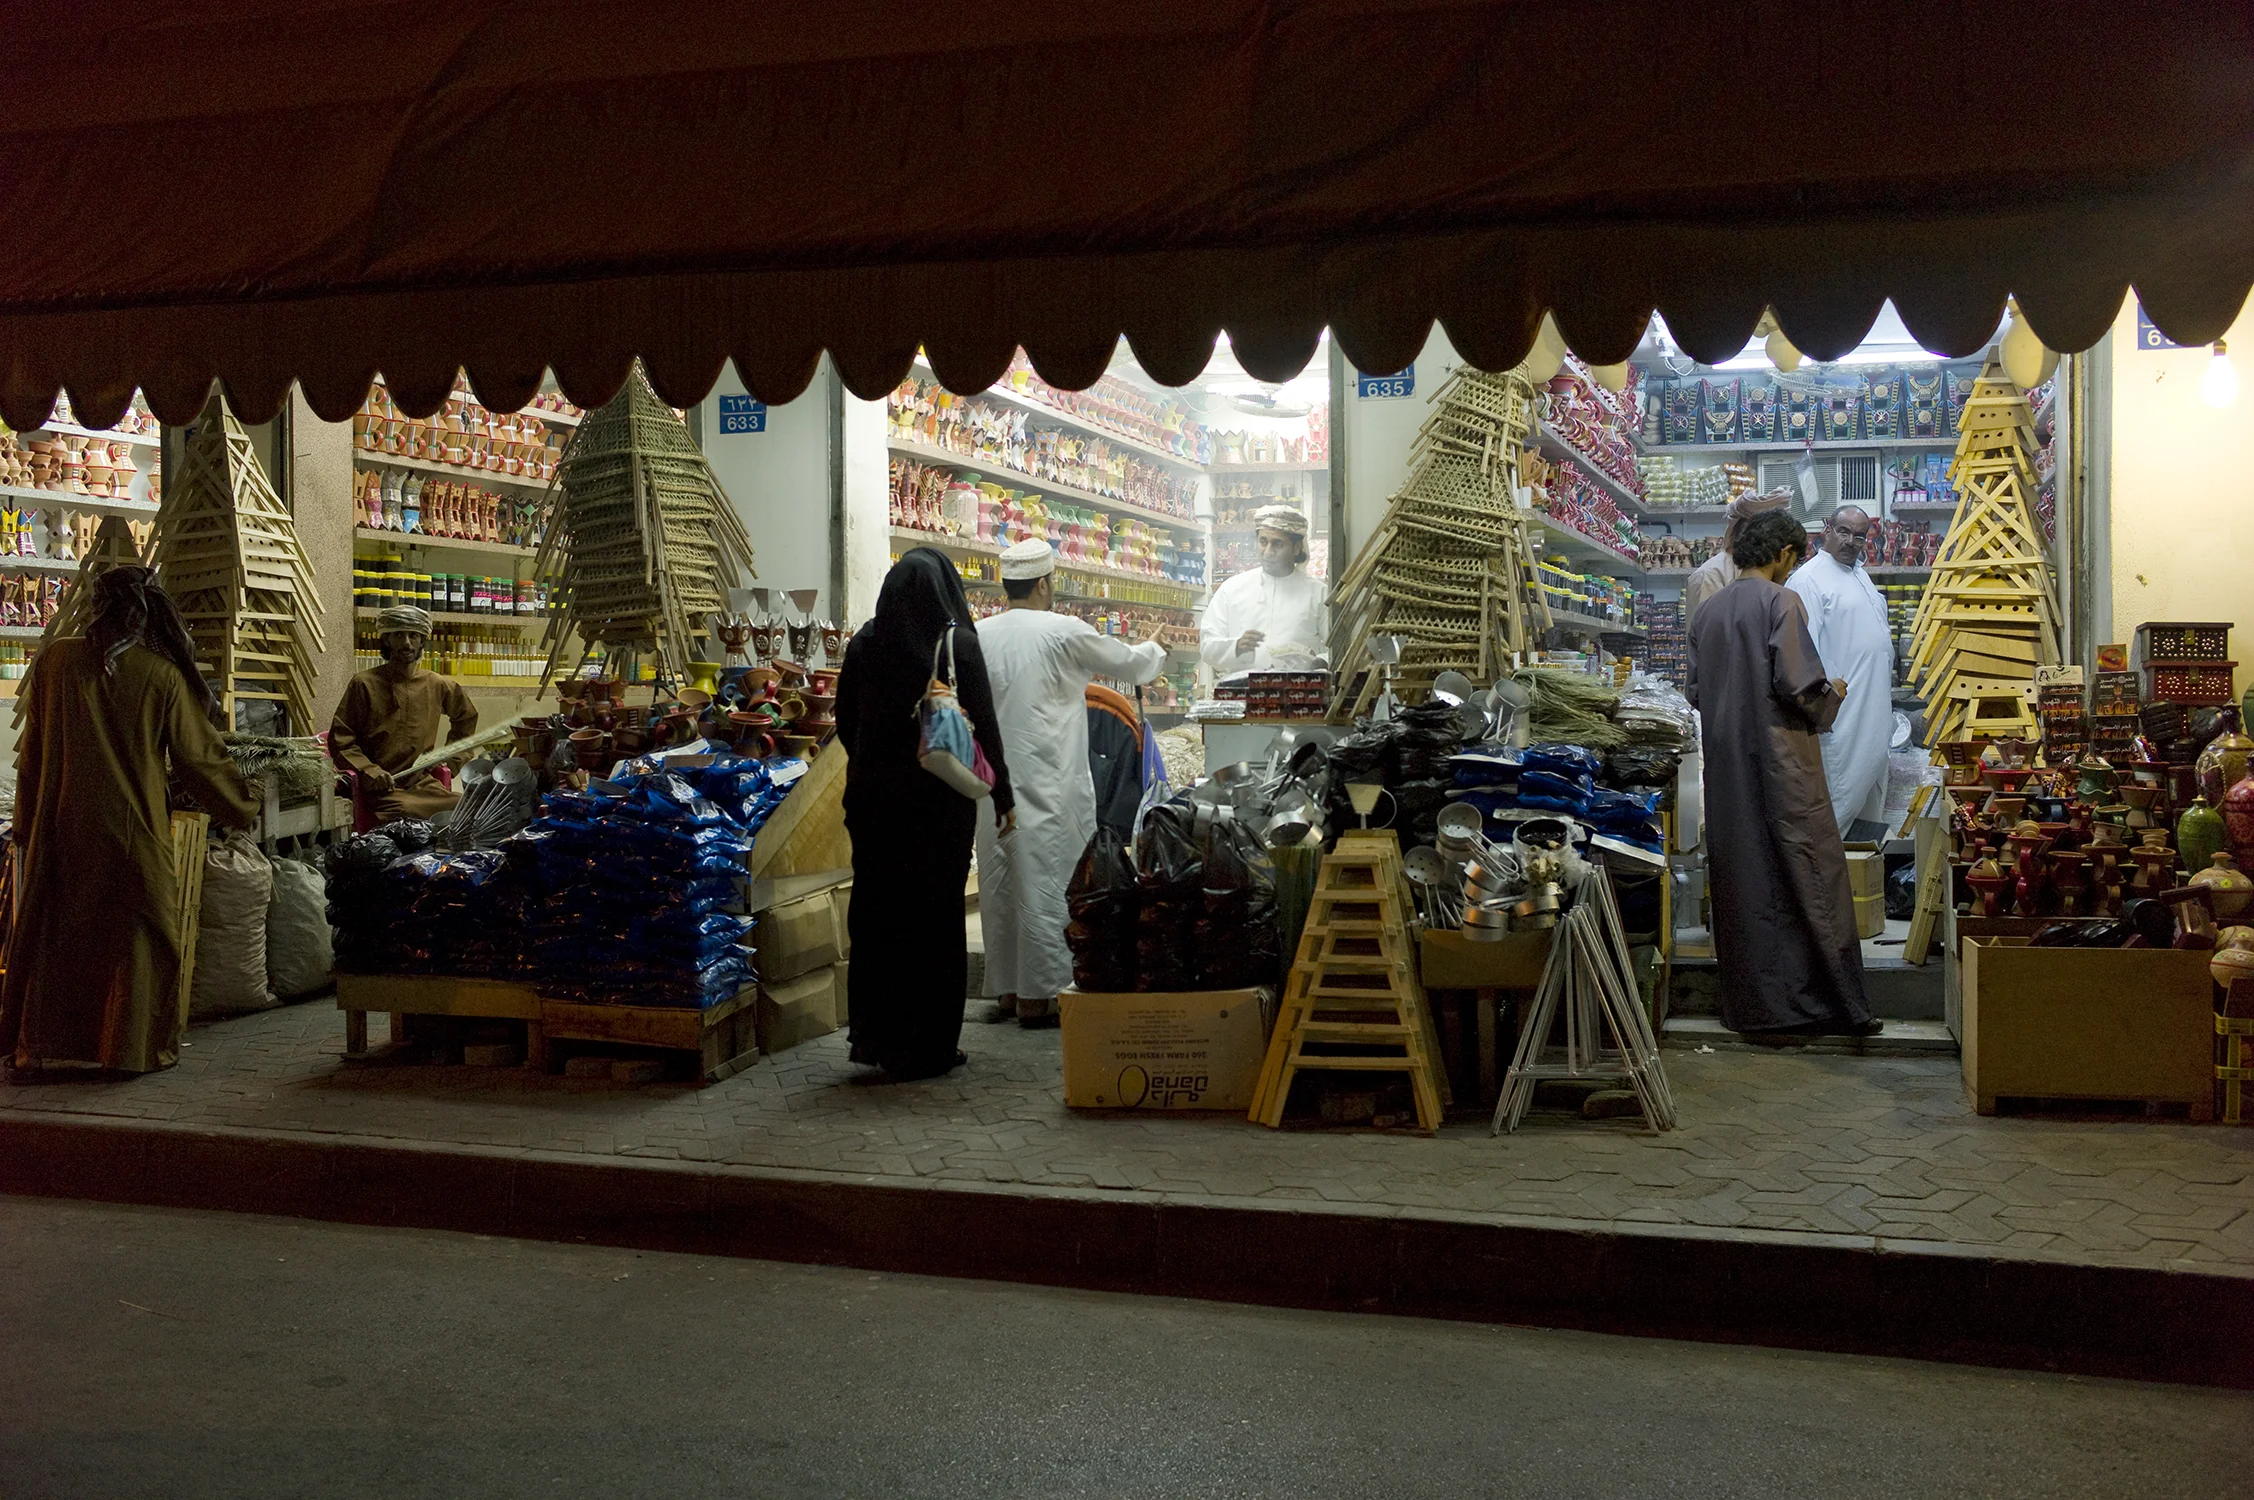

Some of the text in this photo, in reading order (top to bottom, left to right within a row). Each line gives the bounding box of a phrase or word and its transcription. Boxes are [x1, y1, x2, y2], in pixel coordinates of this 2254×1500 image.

[1367, 381, 1405, 397] 635
[727, 415, 759, 431] 633
[1115, 1052, 1138, 1060] EGGS
[1140, 1052, 1165, 1060] FRESH
[1191, 1051, 1207, 1059] 360
[1151, 1076, 1209, 1091] Dana
